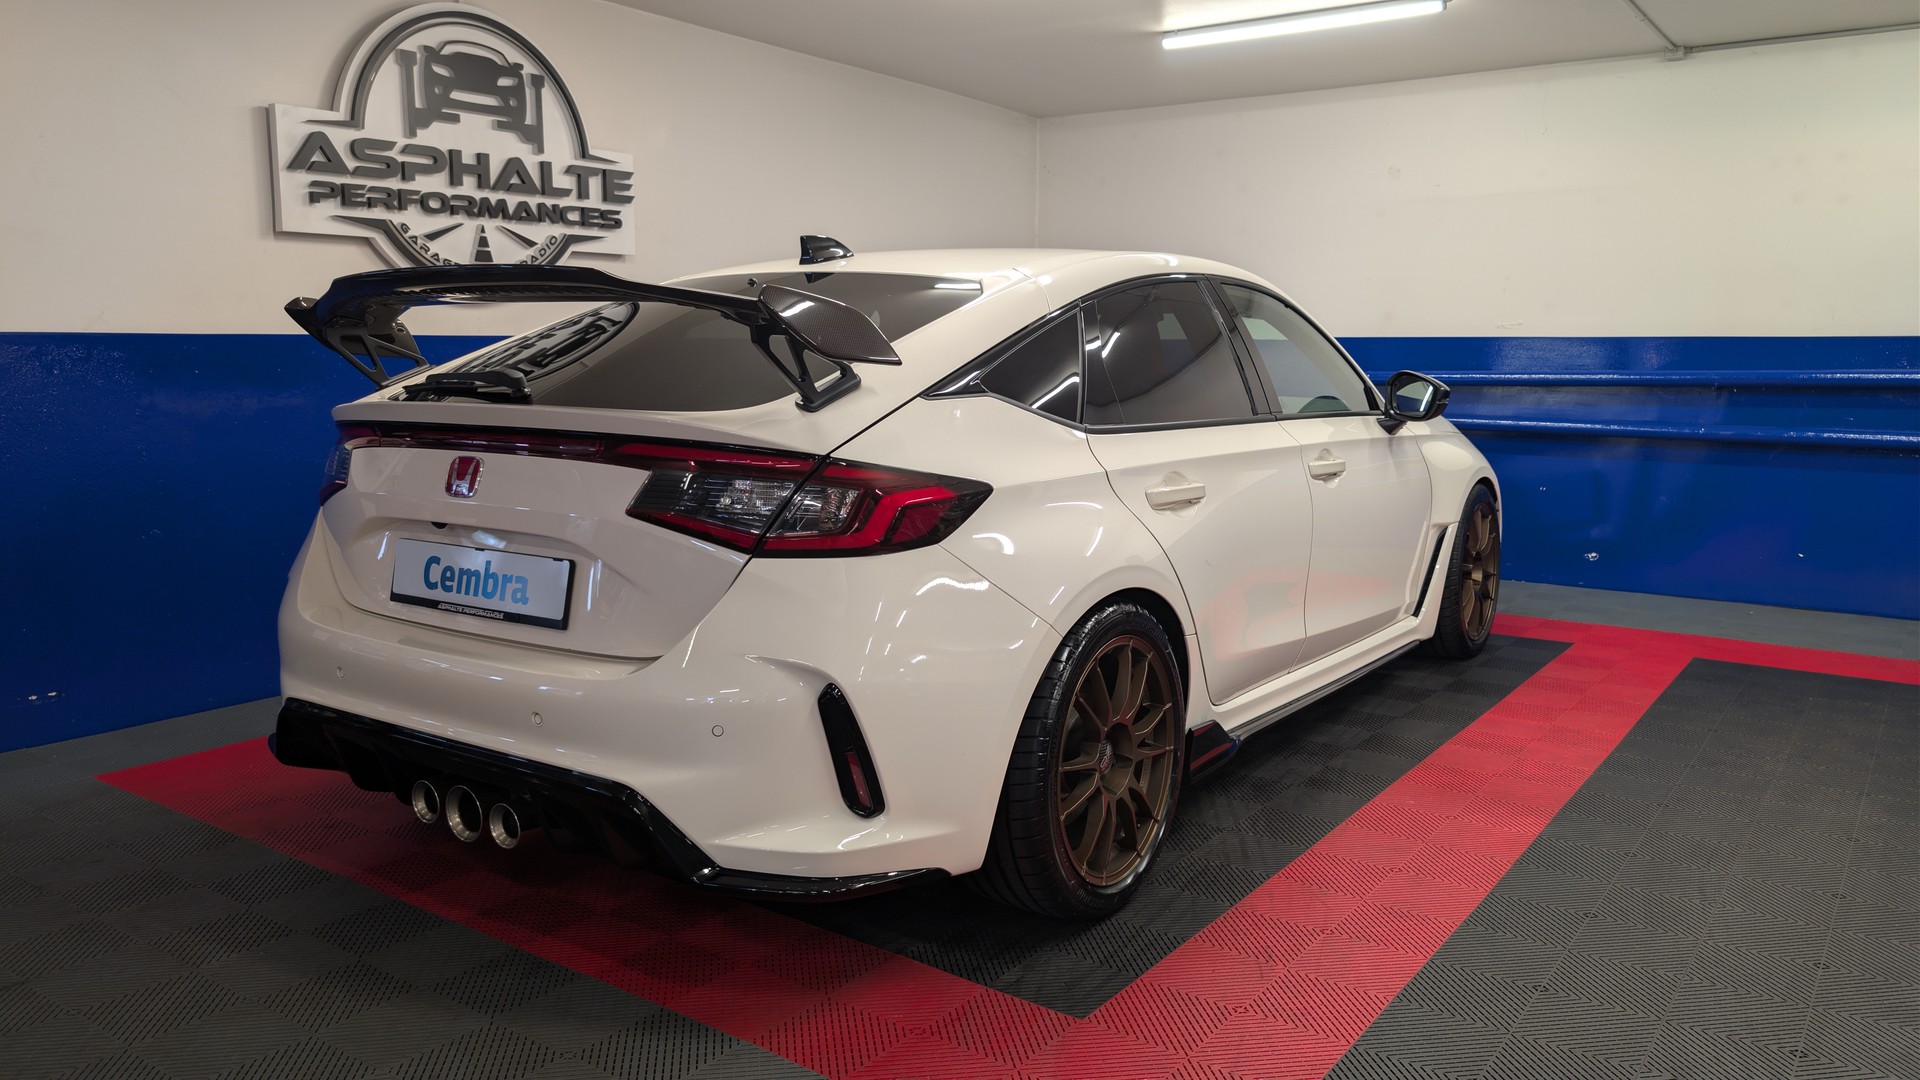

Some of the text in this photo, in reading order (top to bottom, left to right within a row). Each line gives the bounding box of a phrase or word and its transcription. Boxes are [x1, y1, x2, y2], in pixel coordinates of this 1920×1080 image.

[286, 130, 635, 204] ASPHALTE
[308, 179, 623, 230] PERFORMANCES
[400, 222, 461, 265] GARAG
[423, 555, 529, 606] Cembra
[437, 602, 505, 620] ASPHALTE PERFORMANCES
